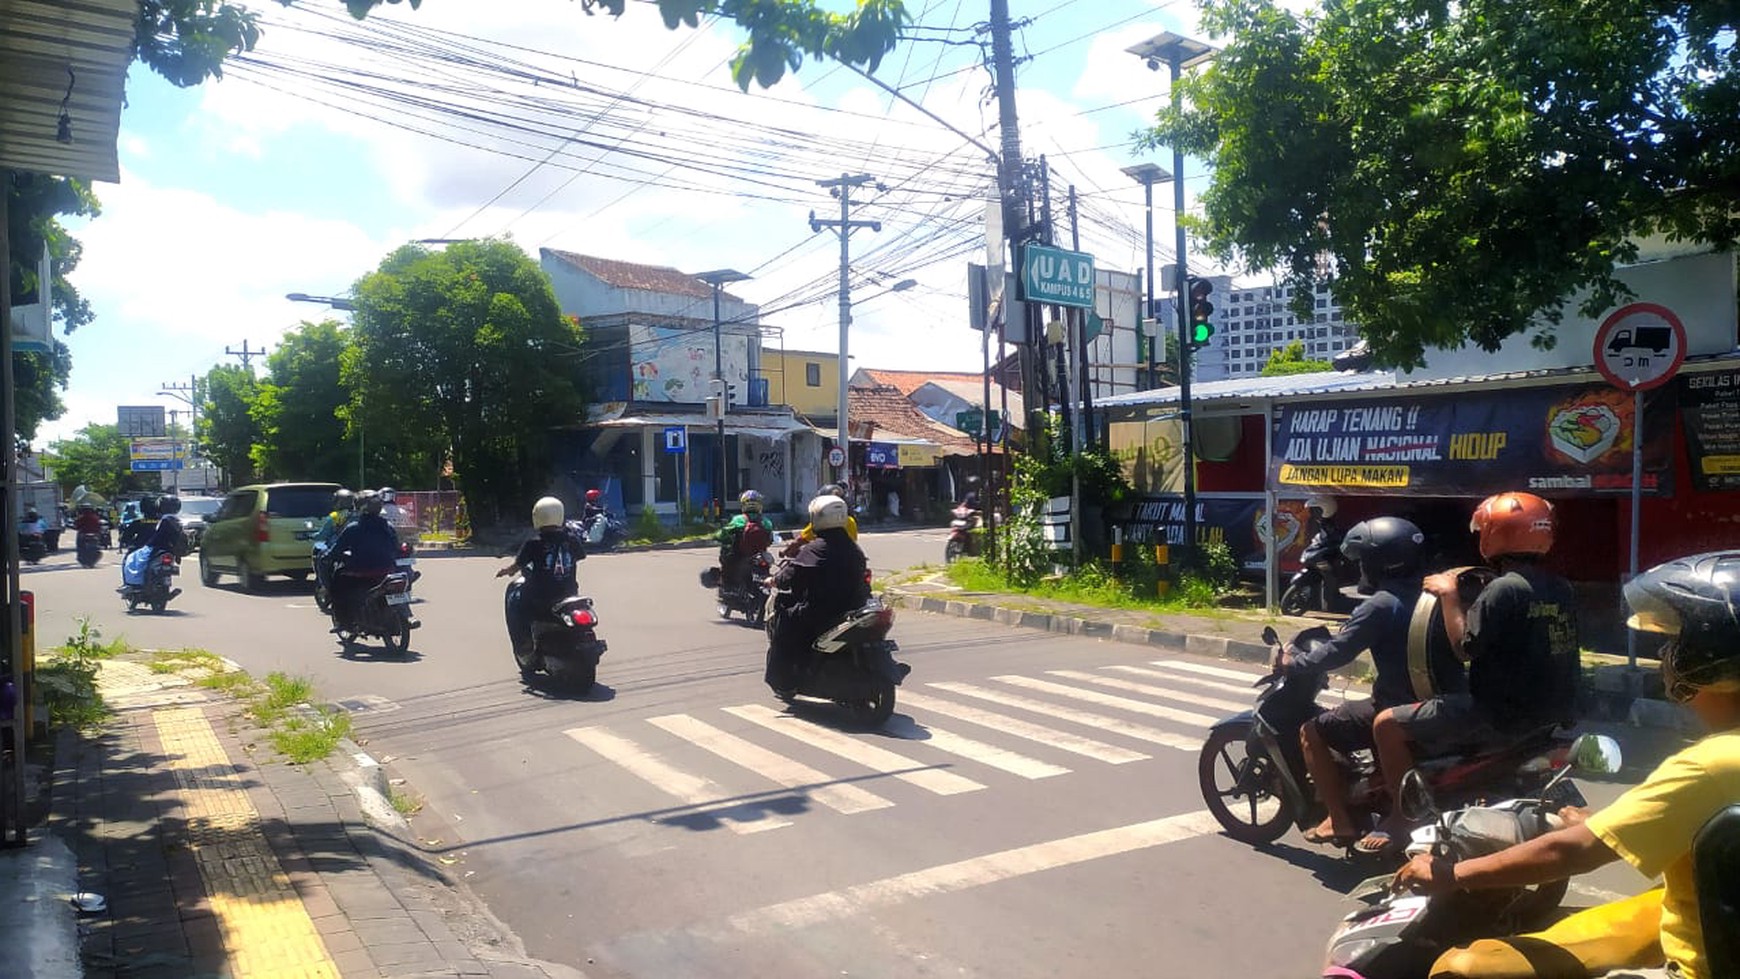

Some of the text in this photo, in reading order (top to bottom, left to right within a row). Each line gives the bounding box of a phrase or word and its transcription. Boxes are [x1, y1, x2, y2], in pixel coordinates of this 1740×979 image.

[1291, 411, 1338, 433] HARAP
[1342, 407, 1402, 432] TENANG
[1284, 432, 1507, 461] ADA UJIAN NASIONAL HIDUP
[1285, 467, 1404, 482] JANGAN LUPA MAKAN
[1528, 474, 1592, 489] sambal
[1169, 502, 1205, 522] MAAL
[1196, 525, 1224, 547] LLAH
